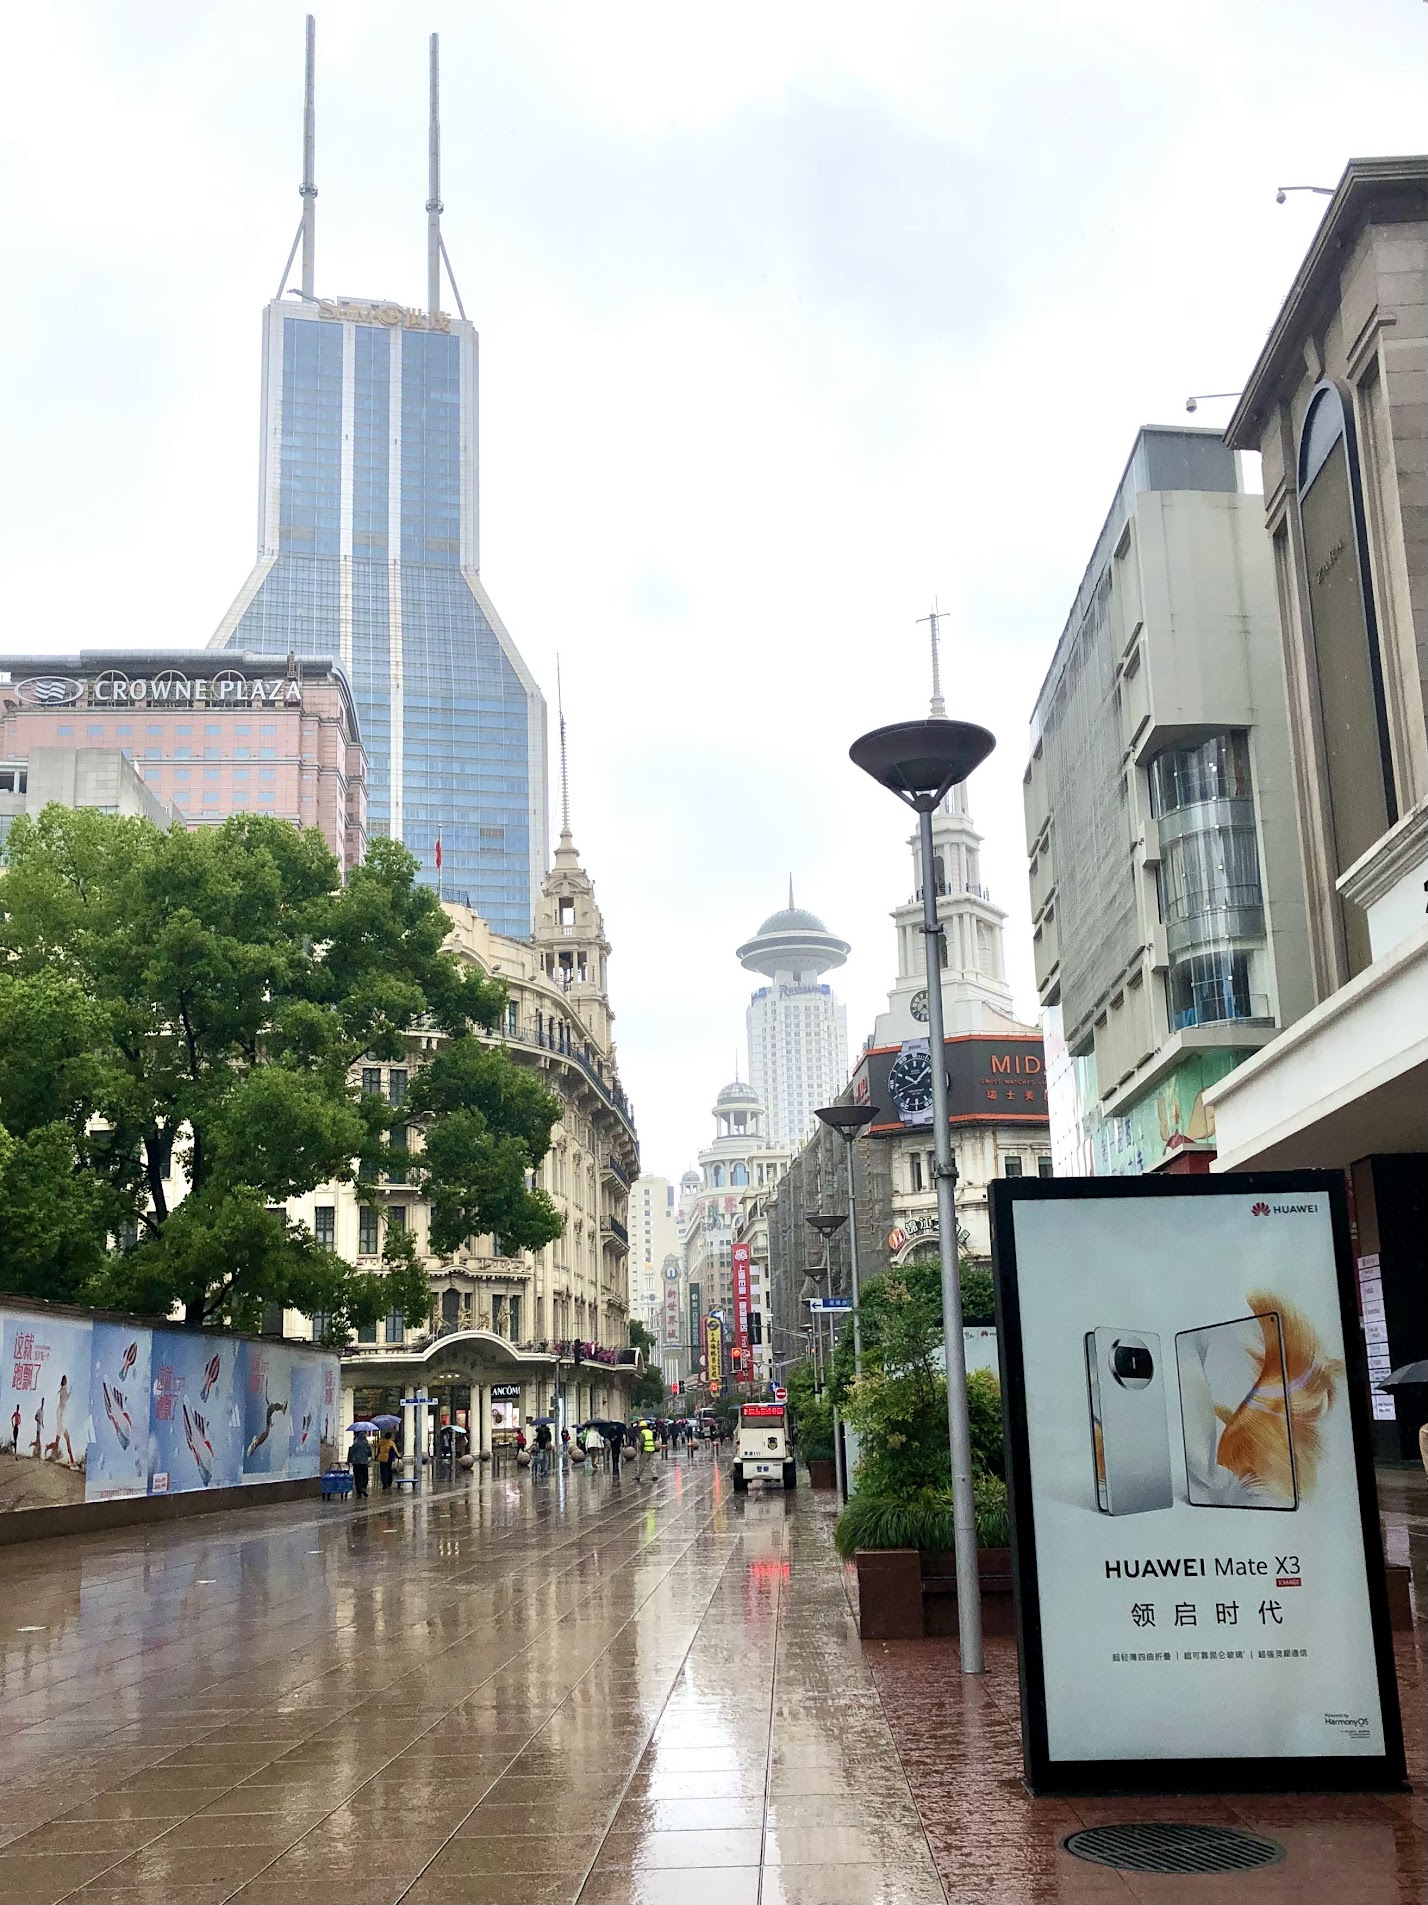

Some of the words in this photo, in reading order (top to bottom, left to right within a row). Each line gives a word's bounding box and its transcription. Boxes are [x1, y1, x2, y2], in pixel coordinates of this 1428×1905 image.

[95, 680, 207, 701] CROWNE
[220, 680, 302, 701] PLAZA
[991, 1055, 1046, 1074] MID
[1273, 1204, 1318, 1214] HUAWEI
[667, 1288, 678, 1340] 新世界城
[13, 1332, 35, 1360] 这就
[491, 1385, 520, 1396] ANCÔM
[1105, 1558, 1205, 1578] HUAWEI
[1215, 1557, 1268, 1576] Mate
[1275, 1556, 1301, 1574] X3
[1131, 1600, 1284, 1627] 领启时代
[1325, 1717, 1369, 1727] HarmonyOS
